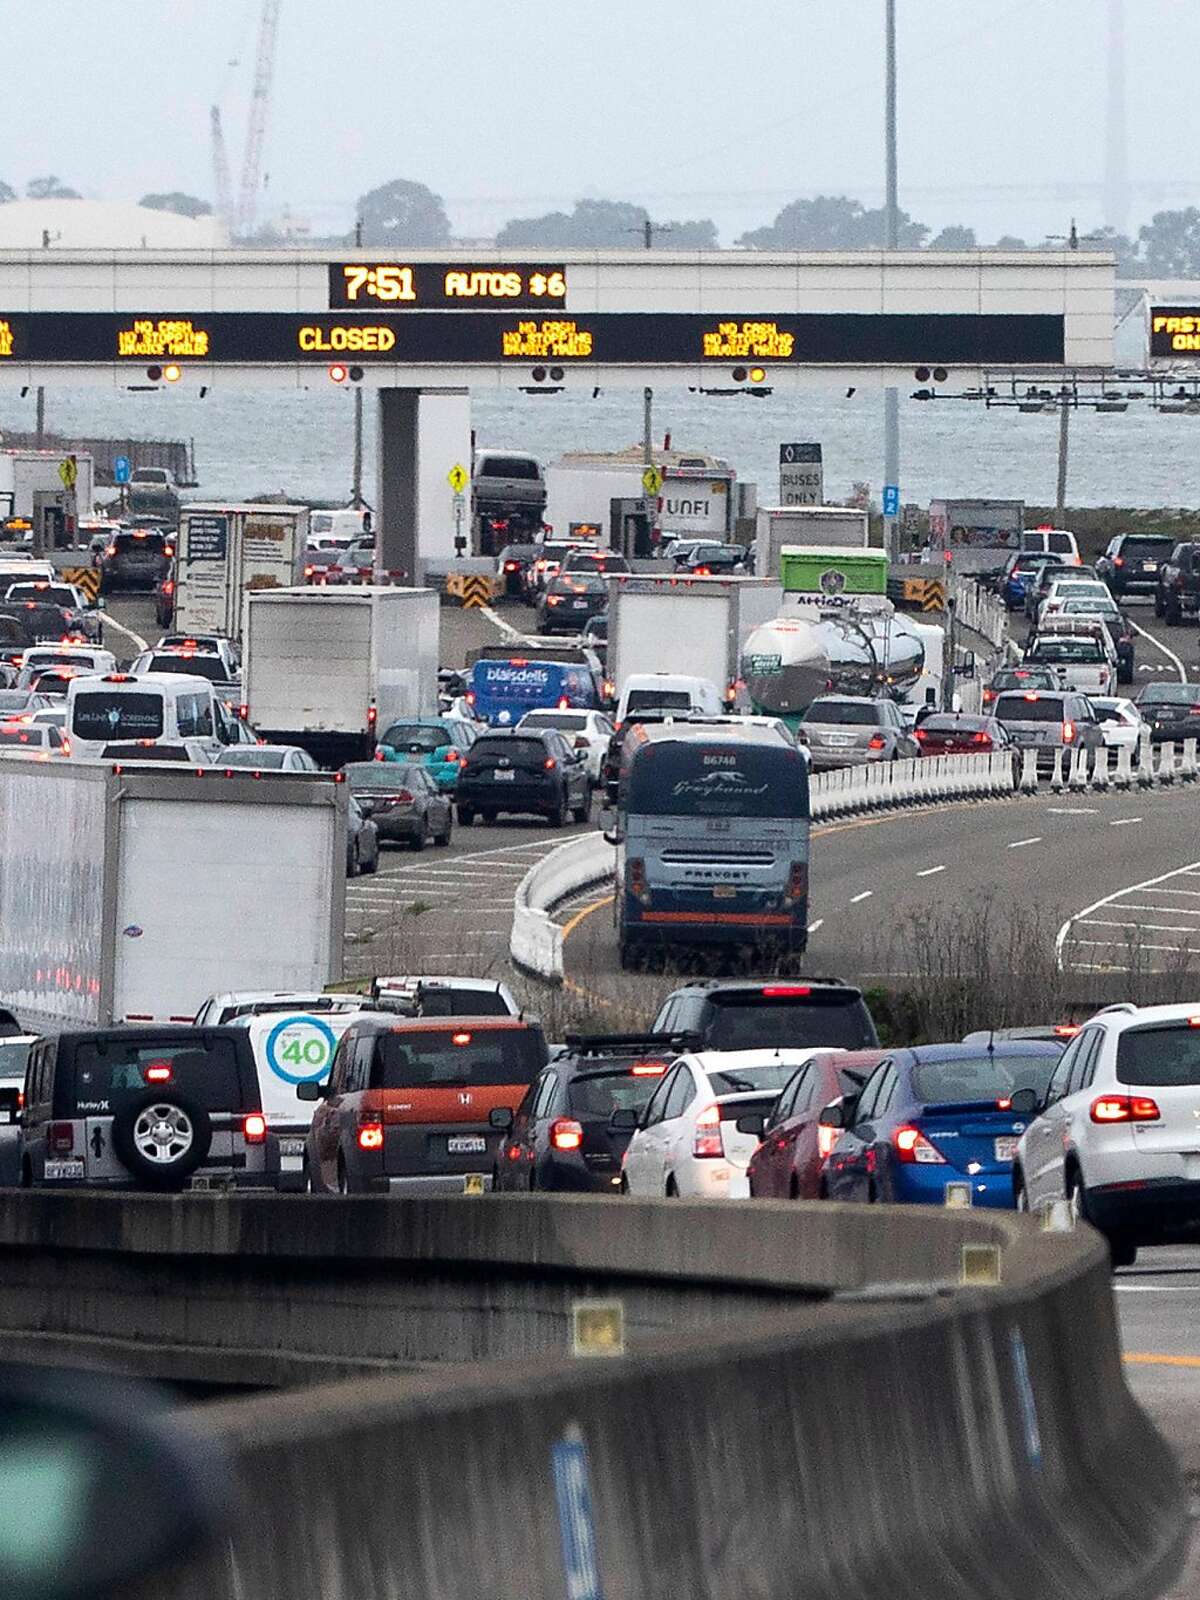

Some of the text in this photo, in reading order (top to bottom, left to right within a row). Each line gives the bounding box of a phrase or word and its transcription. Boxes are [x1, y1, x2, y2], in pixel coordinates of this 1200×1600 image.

[343, 266, 417, 300] 7:51
[445, 272, 567, 297] AUTOS $6
[299, 327, 396, 351] CLOSED
[782, 474, 820, 486] BUSES
[786, 492, 817, 505] ONLY
[671, 780, 769, 796] Greyhound
